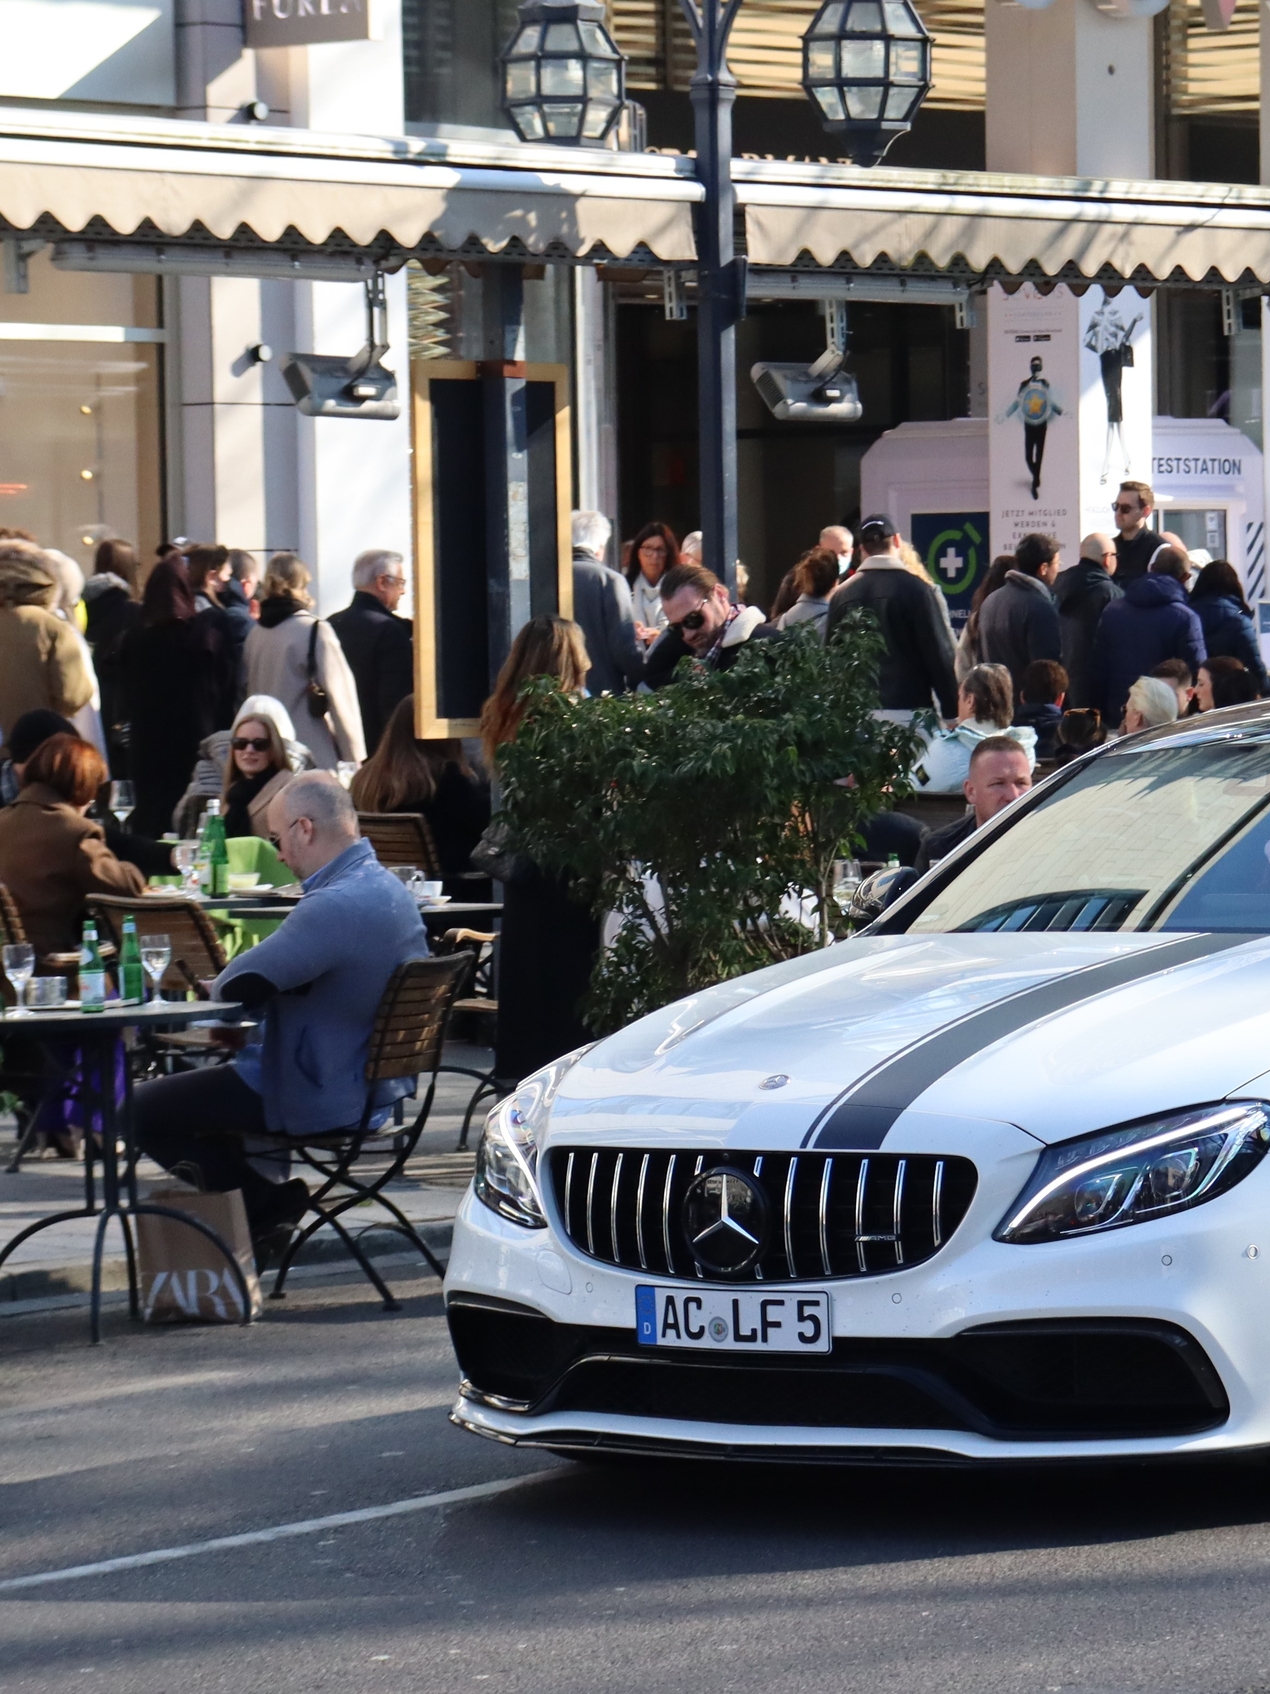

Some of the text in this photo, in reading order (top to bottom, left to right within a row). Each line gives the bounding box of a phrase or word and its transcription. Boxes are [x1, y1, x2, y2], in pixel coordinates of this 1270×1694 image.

[1001, 508, 1068, 518] JETZT MITGLIED
[1013, 520, 1048, 528] WERDEN
[661, 1294, 822, 1344] AC LF 5
[643, 1321, 652, 1335] D
